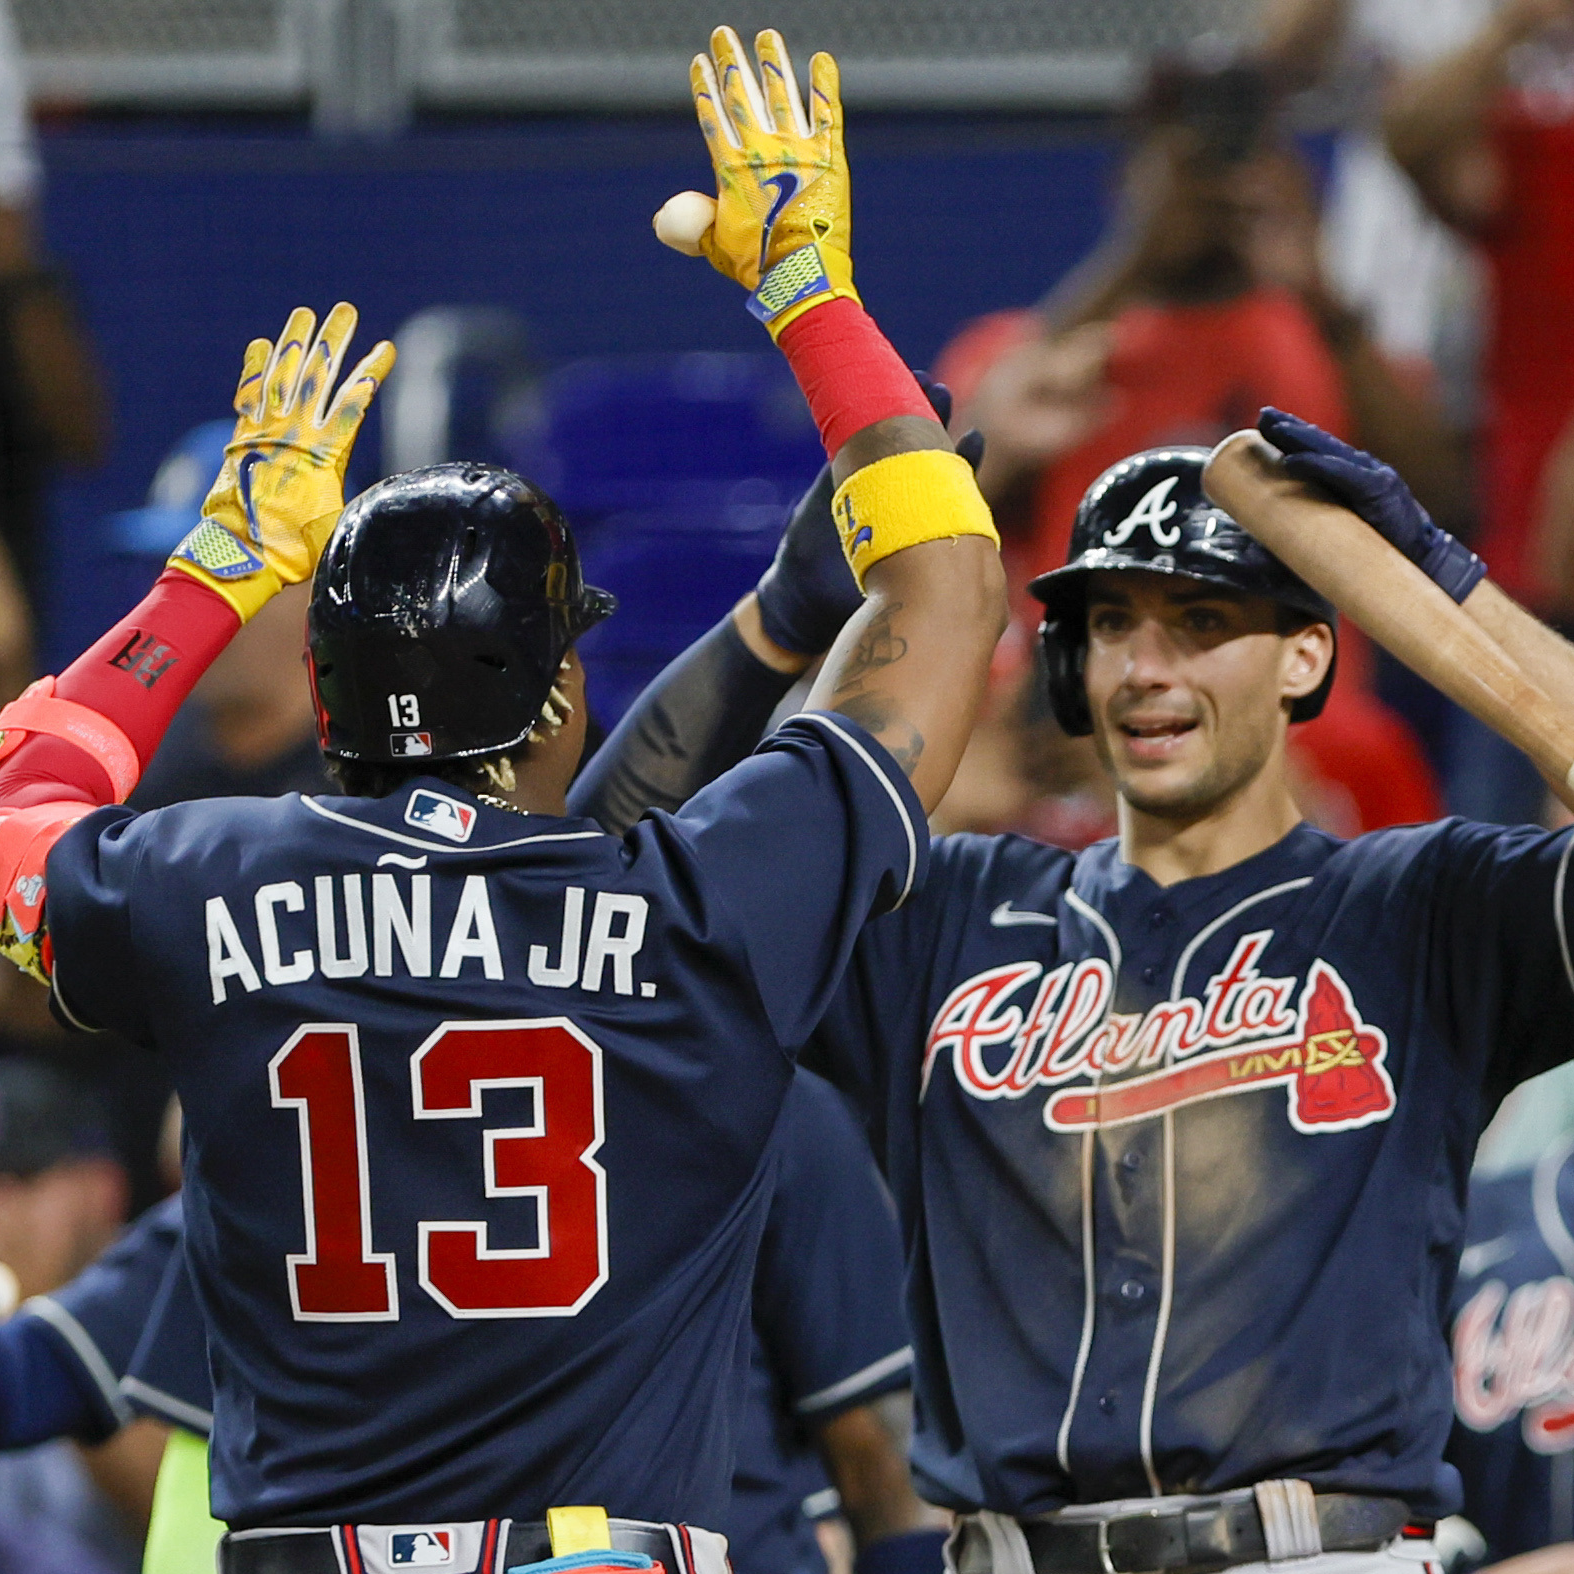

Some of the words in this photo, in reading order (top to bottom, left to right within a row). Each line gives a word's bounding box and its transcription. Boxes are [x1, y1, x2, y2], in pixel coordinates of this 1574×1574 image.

[1102, 475, 1181, 547] A
[387, 693, 421, 728] 13
[205, 853, 505, 1006] ACUÑA
[527, 885, 658, 998] JR.
[919, 929, 1297, 1104] Atlanta
[267, 1016, 610, 1322] 13
